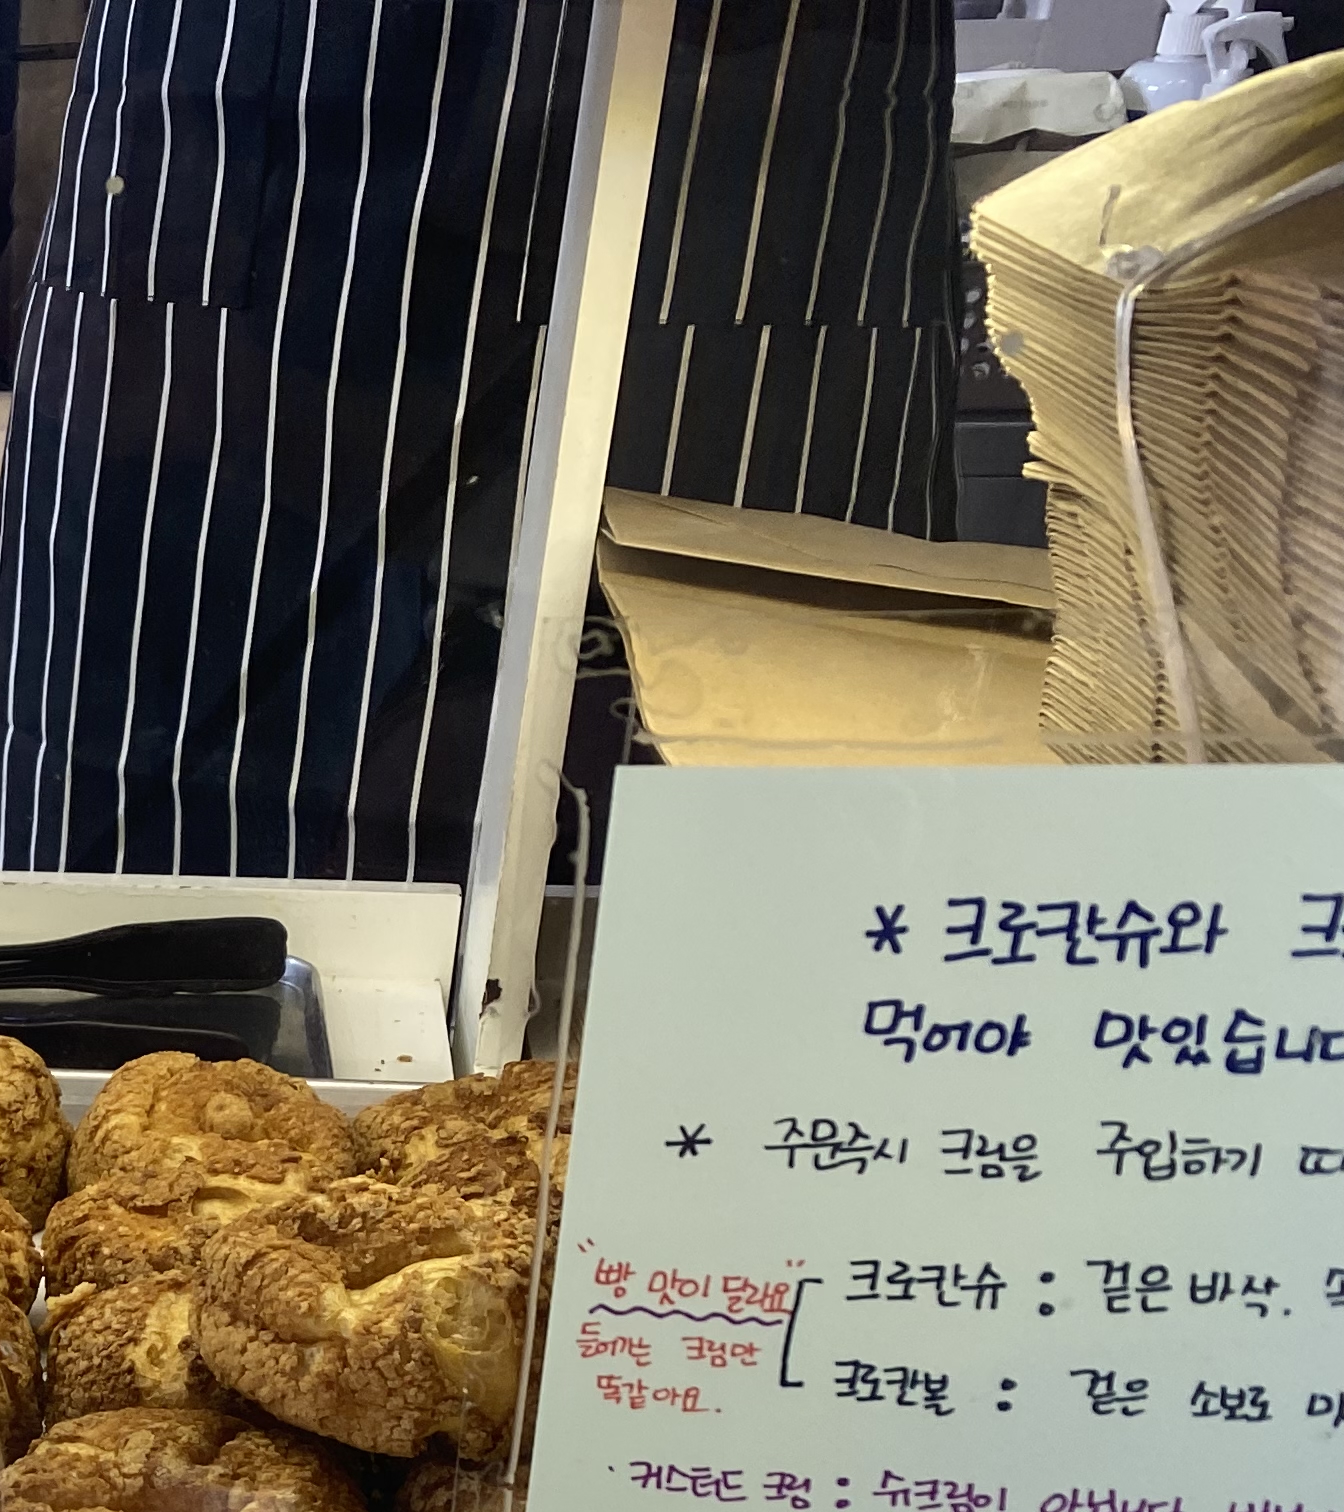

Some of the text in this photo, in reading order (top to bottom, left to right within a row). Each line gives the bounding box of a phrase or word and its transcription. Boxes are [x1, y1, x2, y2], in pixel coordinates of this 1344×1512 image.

[943, 895, 1229, 969] 크로칸슈와
[863, 999, 1033, 1064] 먹어야
[940, 1128, 1043, 1182] 크림을
[1096, 1121, 1264, 1181] 주입하기
[647, 1267, 711, 1306] 맛이
[845, 1259, 1008, 1311] 크로칸슈
[1086, 1259, 1173, 1314] 겉은
[681, 1336, 762, 1368] 크림만
[834, 1359, 956, 1416] 크로칸볼
[1069, 1368, 1151, 1417] 겉은
[1190, 1380, 1274, 1422] 소보로
[629, 1460, 749, 1502] 커스터드
